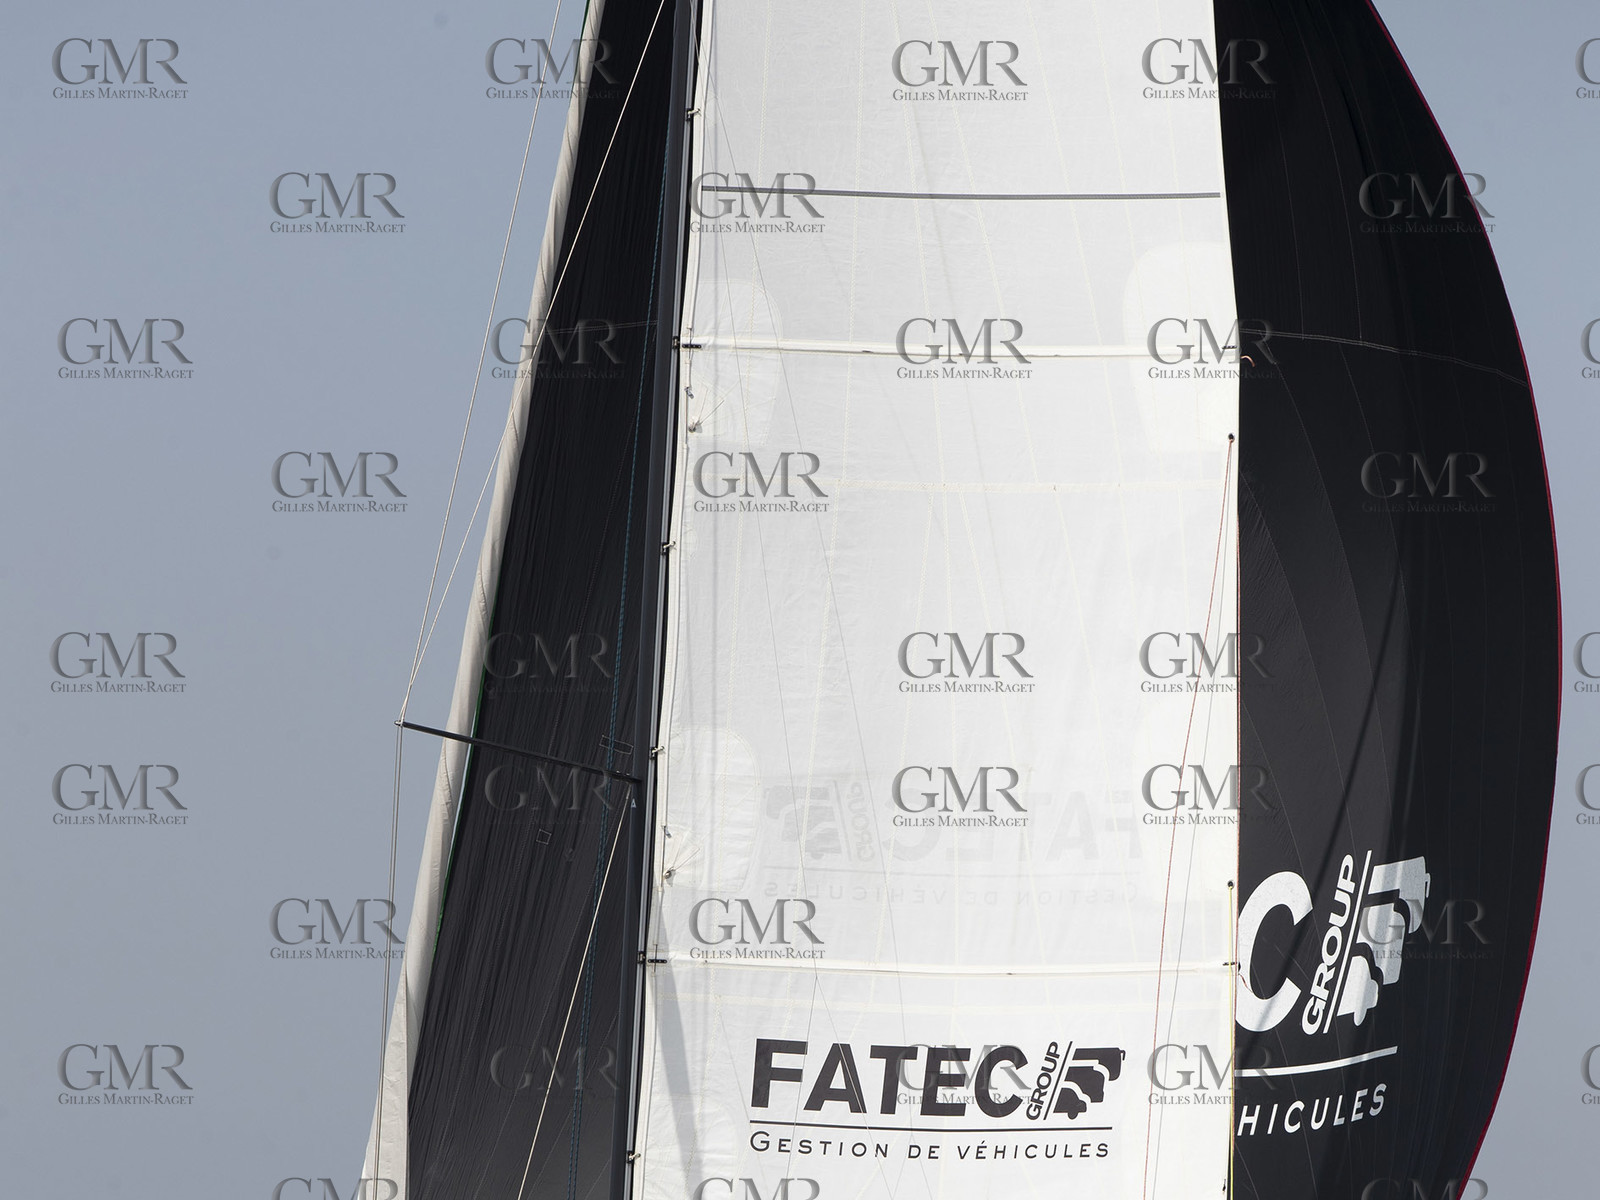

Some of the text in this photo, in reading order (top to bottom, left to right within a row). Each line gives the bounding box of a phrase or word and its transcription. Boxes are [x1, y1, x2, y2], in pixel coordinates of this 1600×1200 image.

[1301, 854, 1356, 1035] GROUP
[751, 1038, 1029, 1118] FATEC
[1026, 1041, 1060, 1120] GROUP
[750, 1131, 1109, 1160] GESTION DE VÉHICULES
